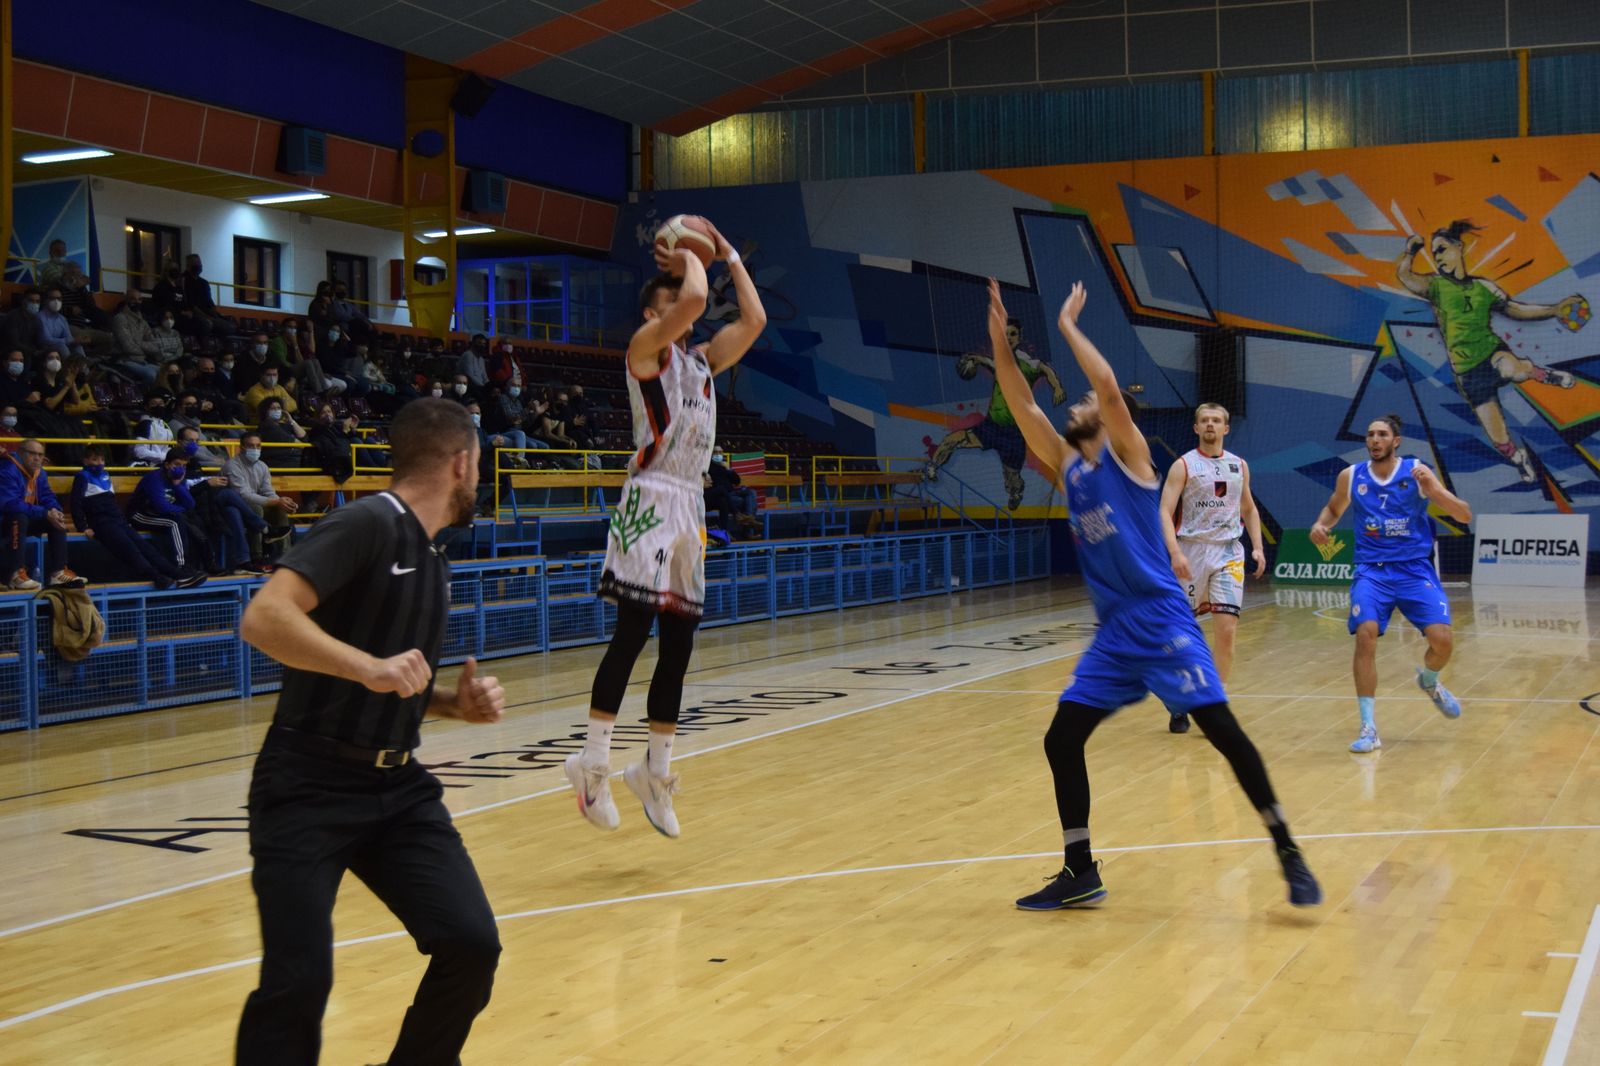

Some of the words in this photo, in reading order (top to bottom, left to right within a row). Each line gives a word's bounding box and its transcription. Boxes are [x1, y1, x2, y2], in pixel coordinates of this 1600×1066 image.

[1214, 466, 1221, 476] 2
[1195, 500, 1226, 508] INNOVA
[1378, 494, 1389, 509] 7
[1501, 539, 1580, 557] LOFRISA
[1274, 562, 1314, 579] CAJA
[1188, 584, 1195, 597] 2
[1439, 601, 1448, 617] 7
[831, 661, 971, 676] de
